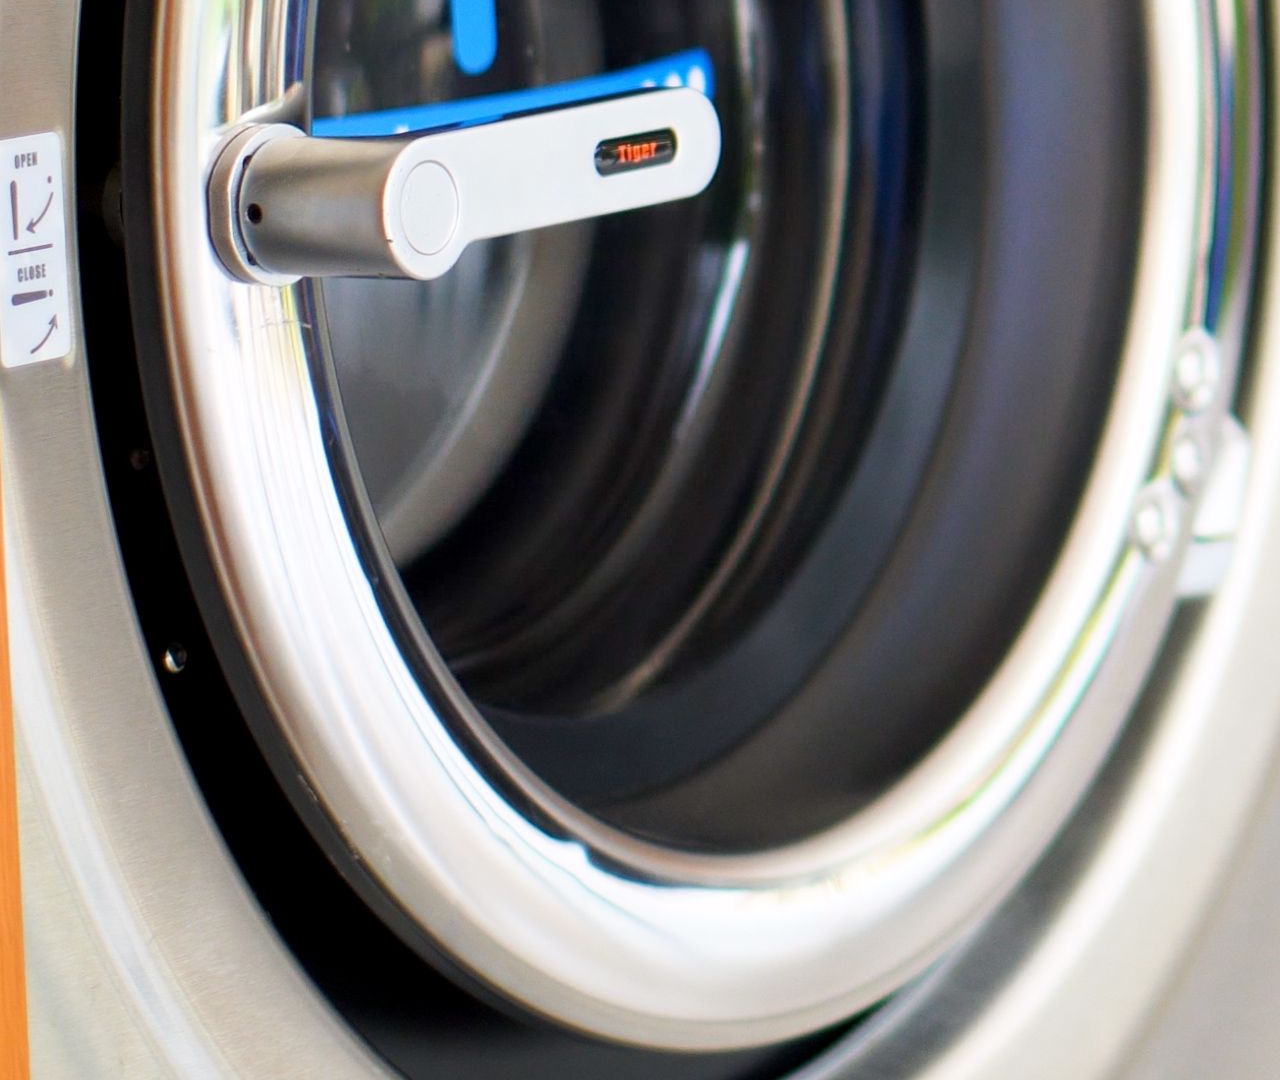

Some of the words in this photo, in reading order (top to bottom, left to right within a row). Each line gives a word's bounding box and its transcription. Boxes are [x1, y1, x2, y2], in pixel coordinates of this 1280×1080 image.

[14, 152, 38, 169] OPEN
[618, 142, 657, 163] Tiger
[18, 264, 46, 282] CLOSE
